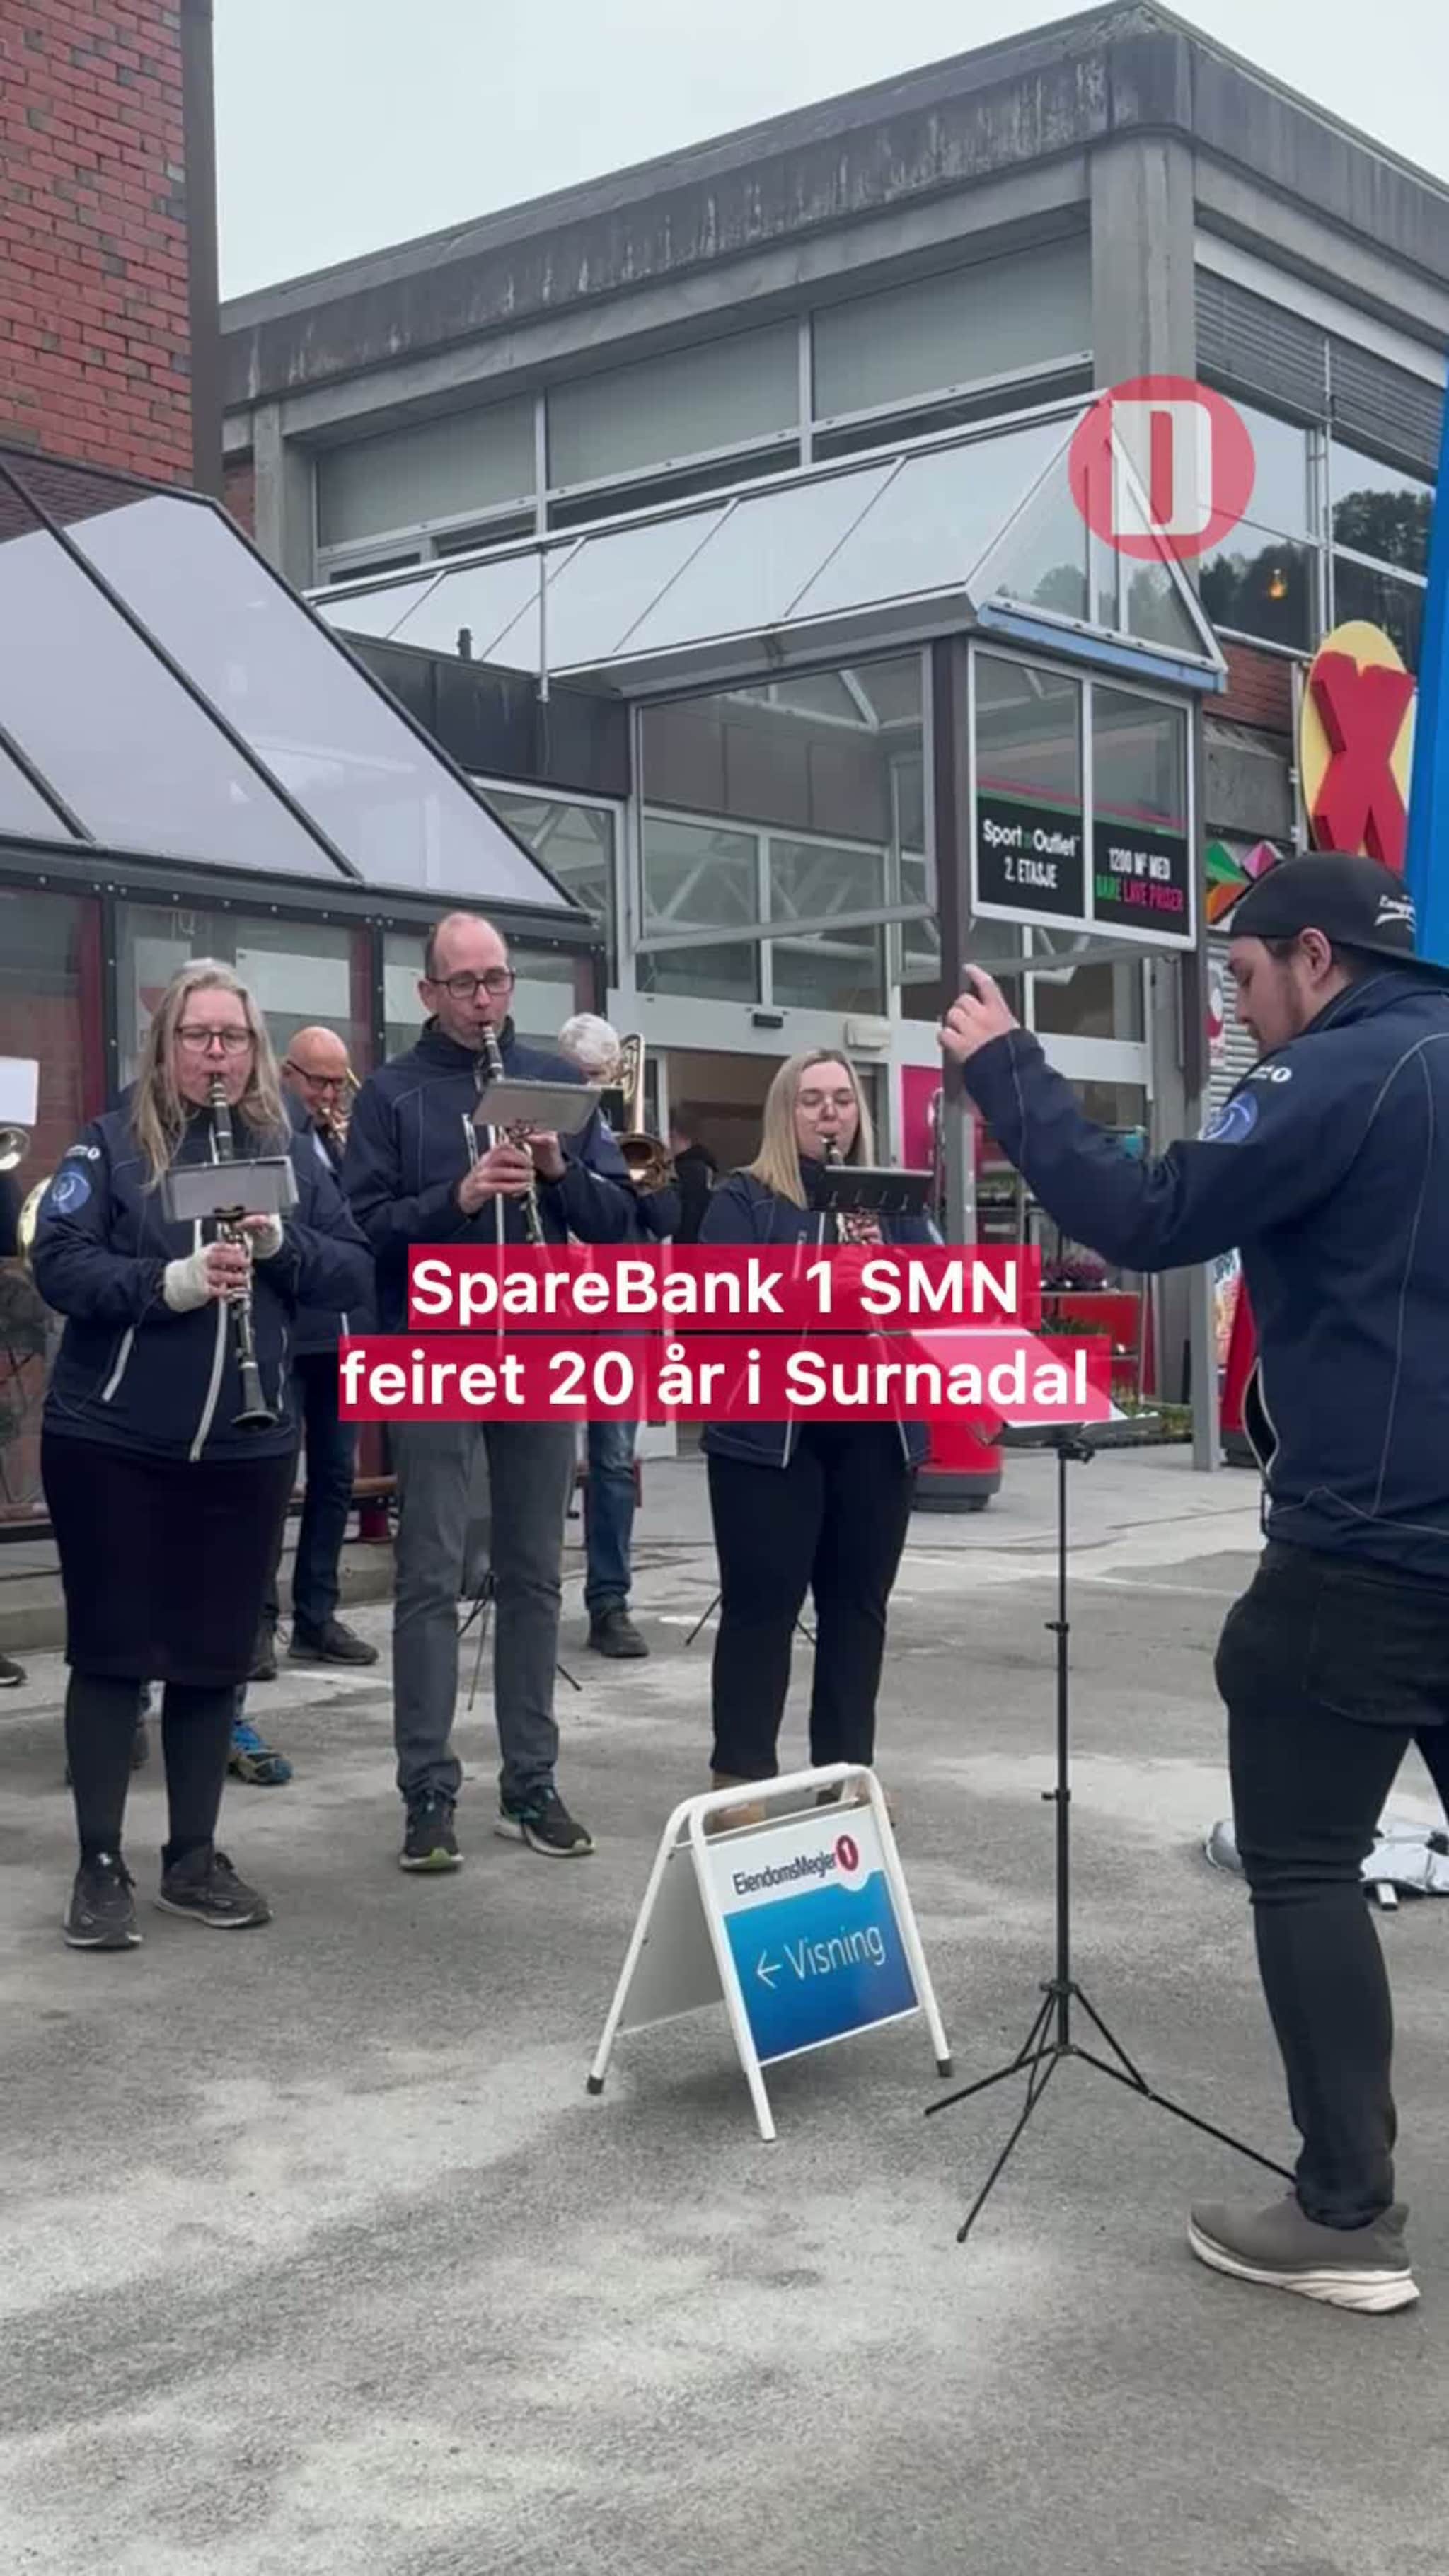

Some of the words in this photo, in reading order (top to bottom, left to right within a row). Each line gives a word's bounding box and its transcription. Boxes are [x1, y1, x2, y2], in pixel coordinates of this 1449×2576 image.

[983, 818, 1022, 848] Sport
[1032, 828, 1075, 857] Outlet
[1017, 857, 1058, 889] ETASJE
[1109, 847, 1132, 874] 1200
[1149, 854, 1170, 881] MED
[1123, 878, 1148, 906] LAVE
[1149, 882, 1184, 913] PRISER
[783, 1924, 886, 1981] Visning
